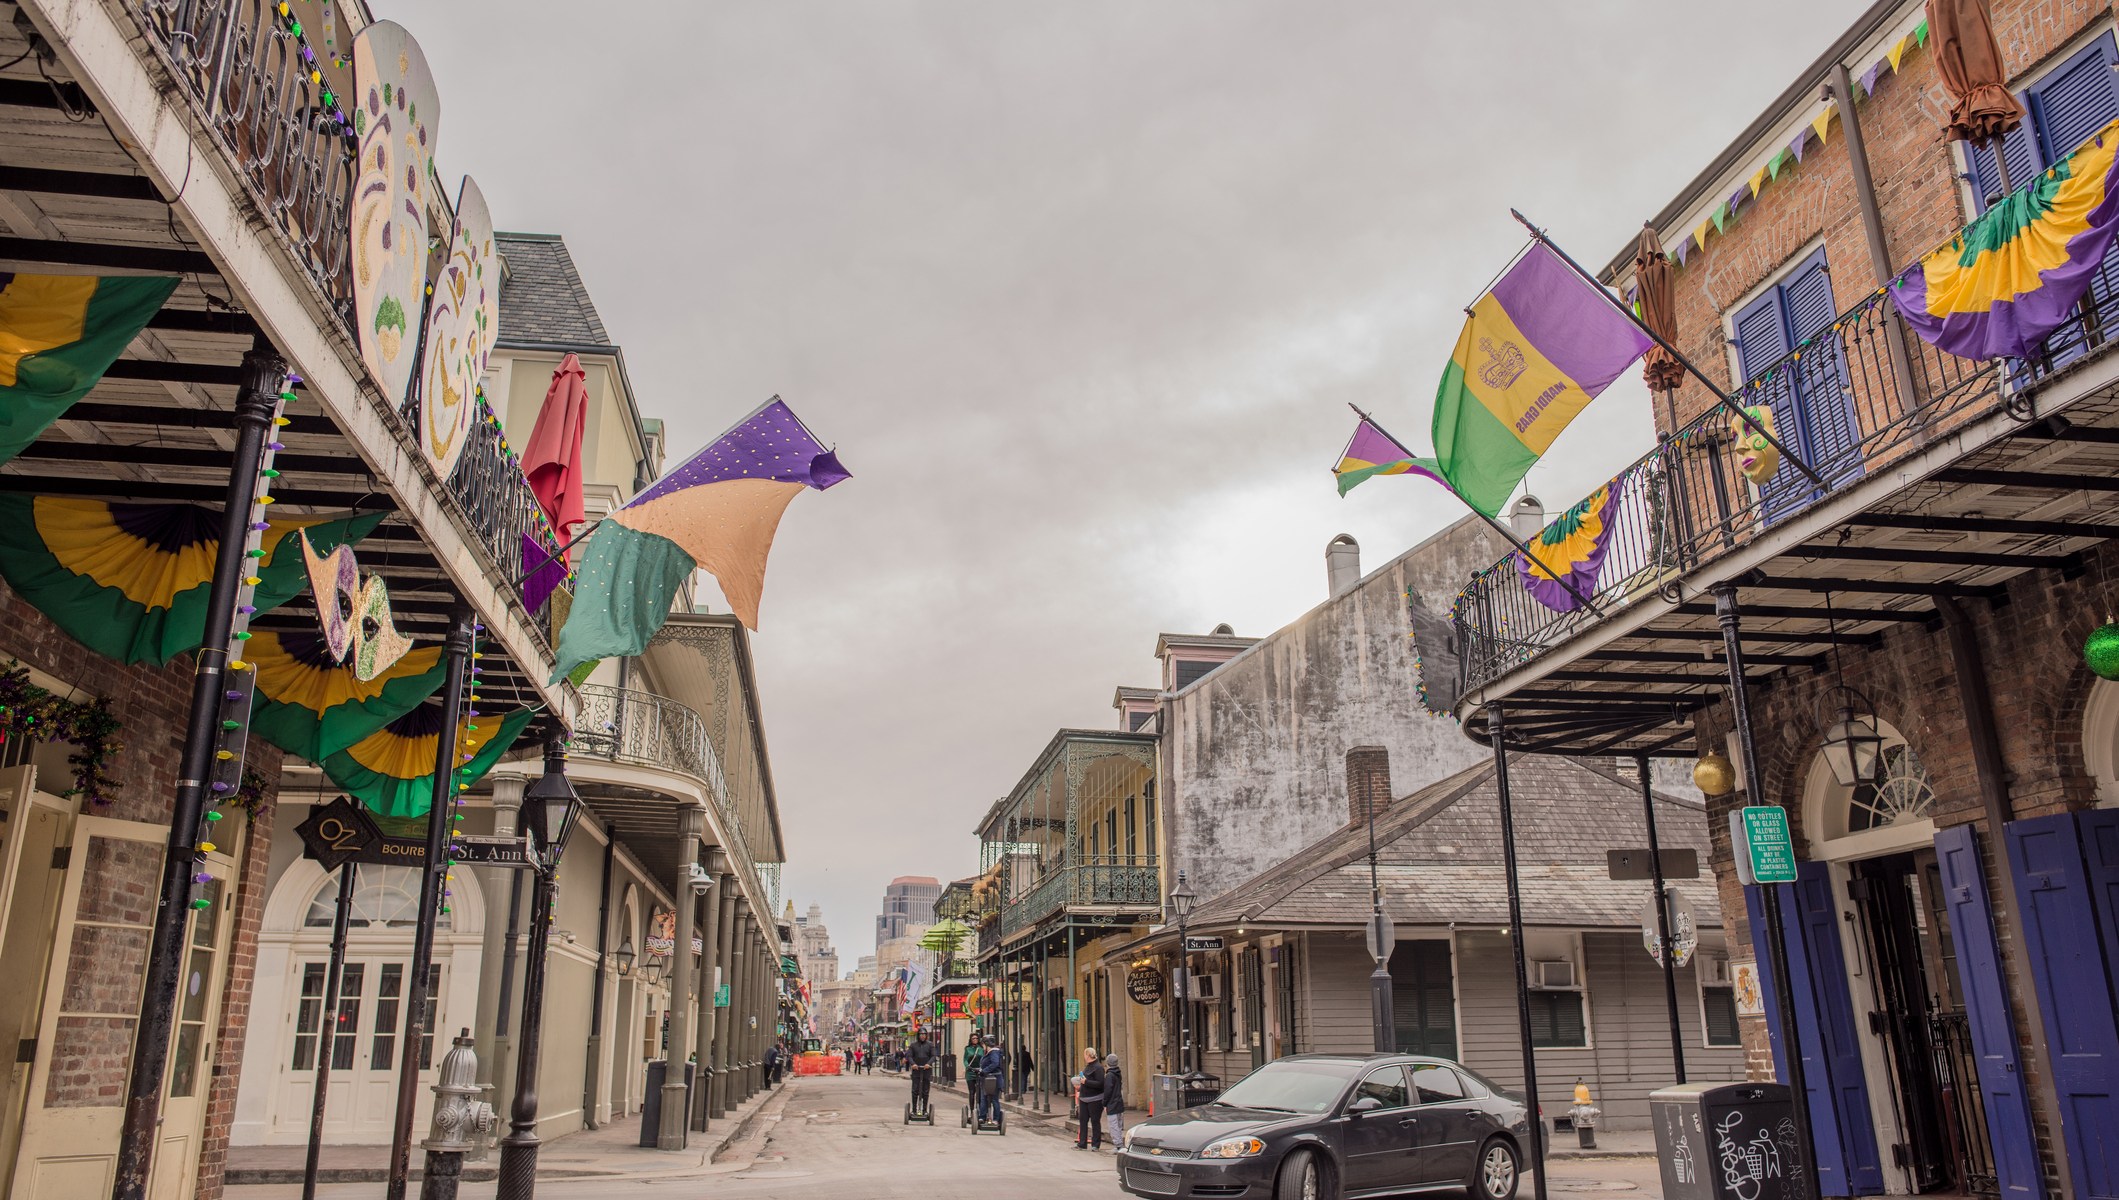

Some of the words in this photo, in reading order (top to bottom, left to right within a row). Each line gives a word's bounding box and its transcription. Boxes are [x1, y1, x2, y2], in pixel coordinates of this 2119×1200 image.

[382, 844, 425, 857] BOURB
[457, 845, 480, 859] St.
[486, 846, 522, 860] Ann
[1203, 940, 1219, 948] Ann
[1134, 984, 1157, 992] HOUSE
[1135, 992, 1160, 1000] VOODOO
